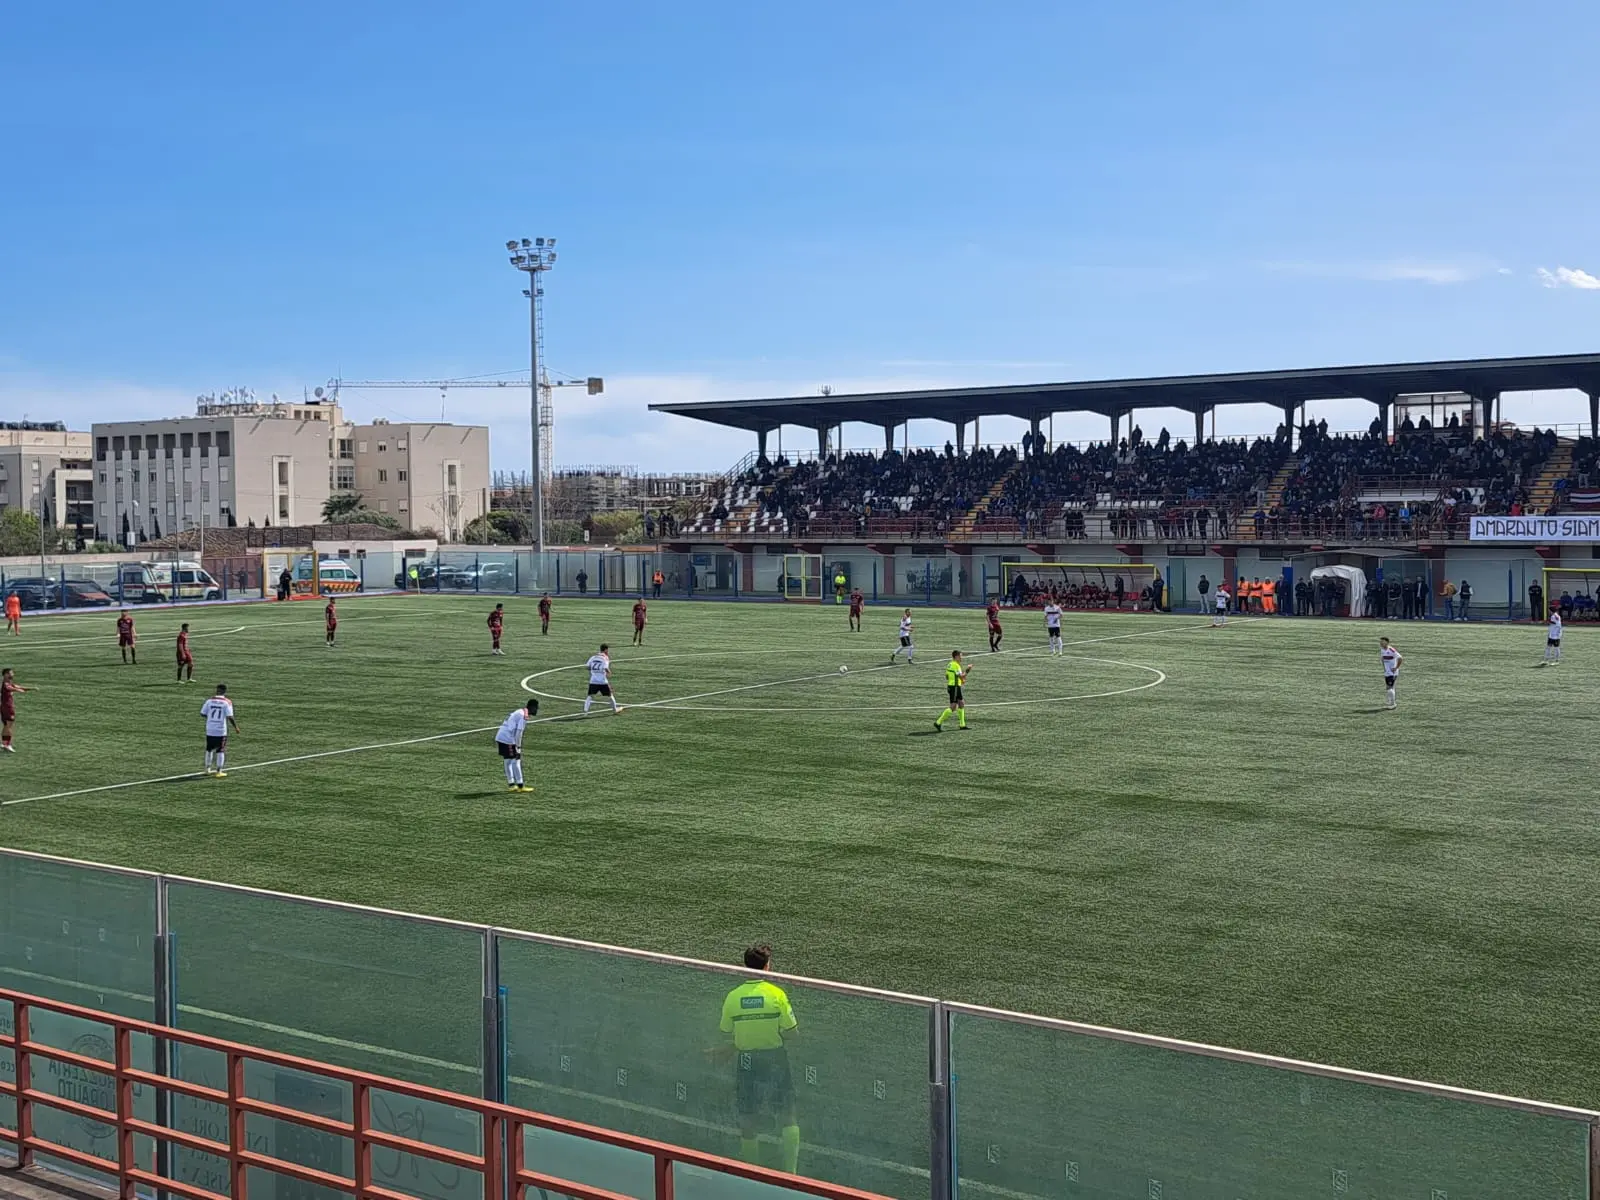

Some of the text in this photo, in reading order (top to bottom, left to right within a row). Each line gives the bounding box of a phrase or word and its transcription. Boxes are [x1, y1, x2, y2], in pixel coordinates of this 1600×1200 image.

[1475, 519, 1599, 536] AMARANTO SIAM
[210, 705, 222, 719] 71
